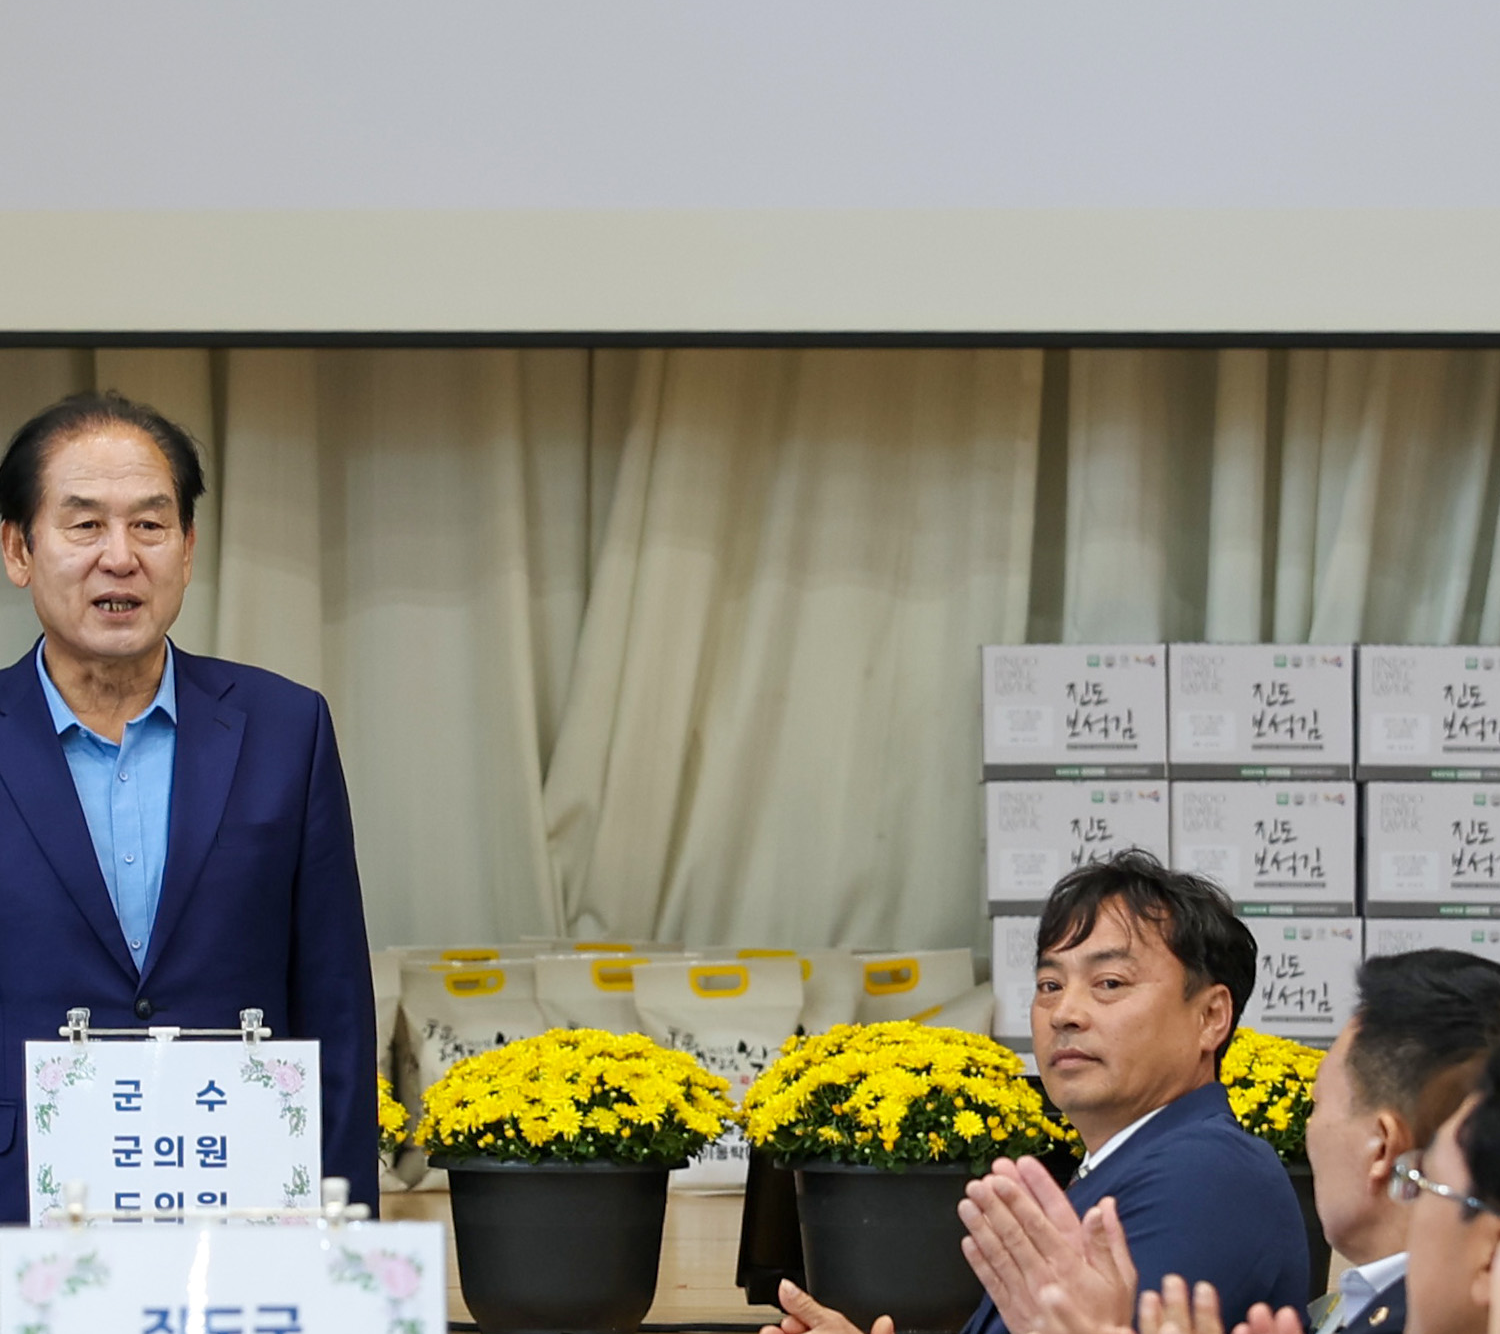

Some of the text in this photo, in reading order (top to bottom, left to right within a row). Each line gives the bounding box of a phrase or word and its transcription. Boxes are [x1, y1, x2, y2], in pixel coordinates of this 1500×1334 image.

[1066, 680, 1110, 706] 진도
[1252, 680, 1296, 706] 진도
[1443, 682, 1487, 708] 진도
[1071, 817, 1115, 843] 진도
[1254, 817, 1298, 843] 진도
[1452, 819, 1496, 845] 진도
[1262, 953, 1306, 978] 진도
[112, 1135, 227, 1168] 군의원
